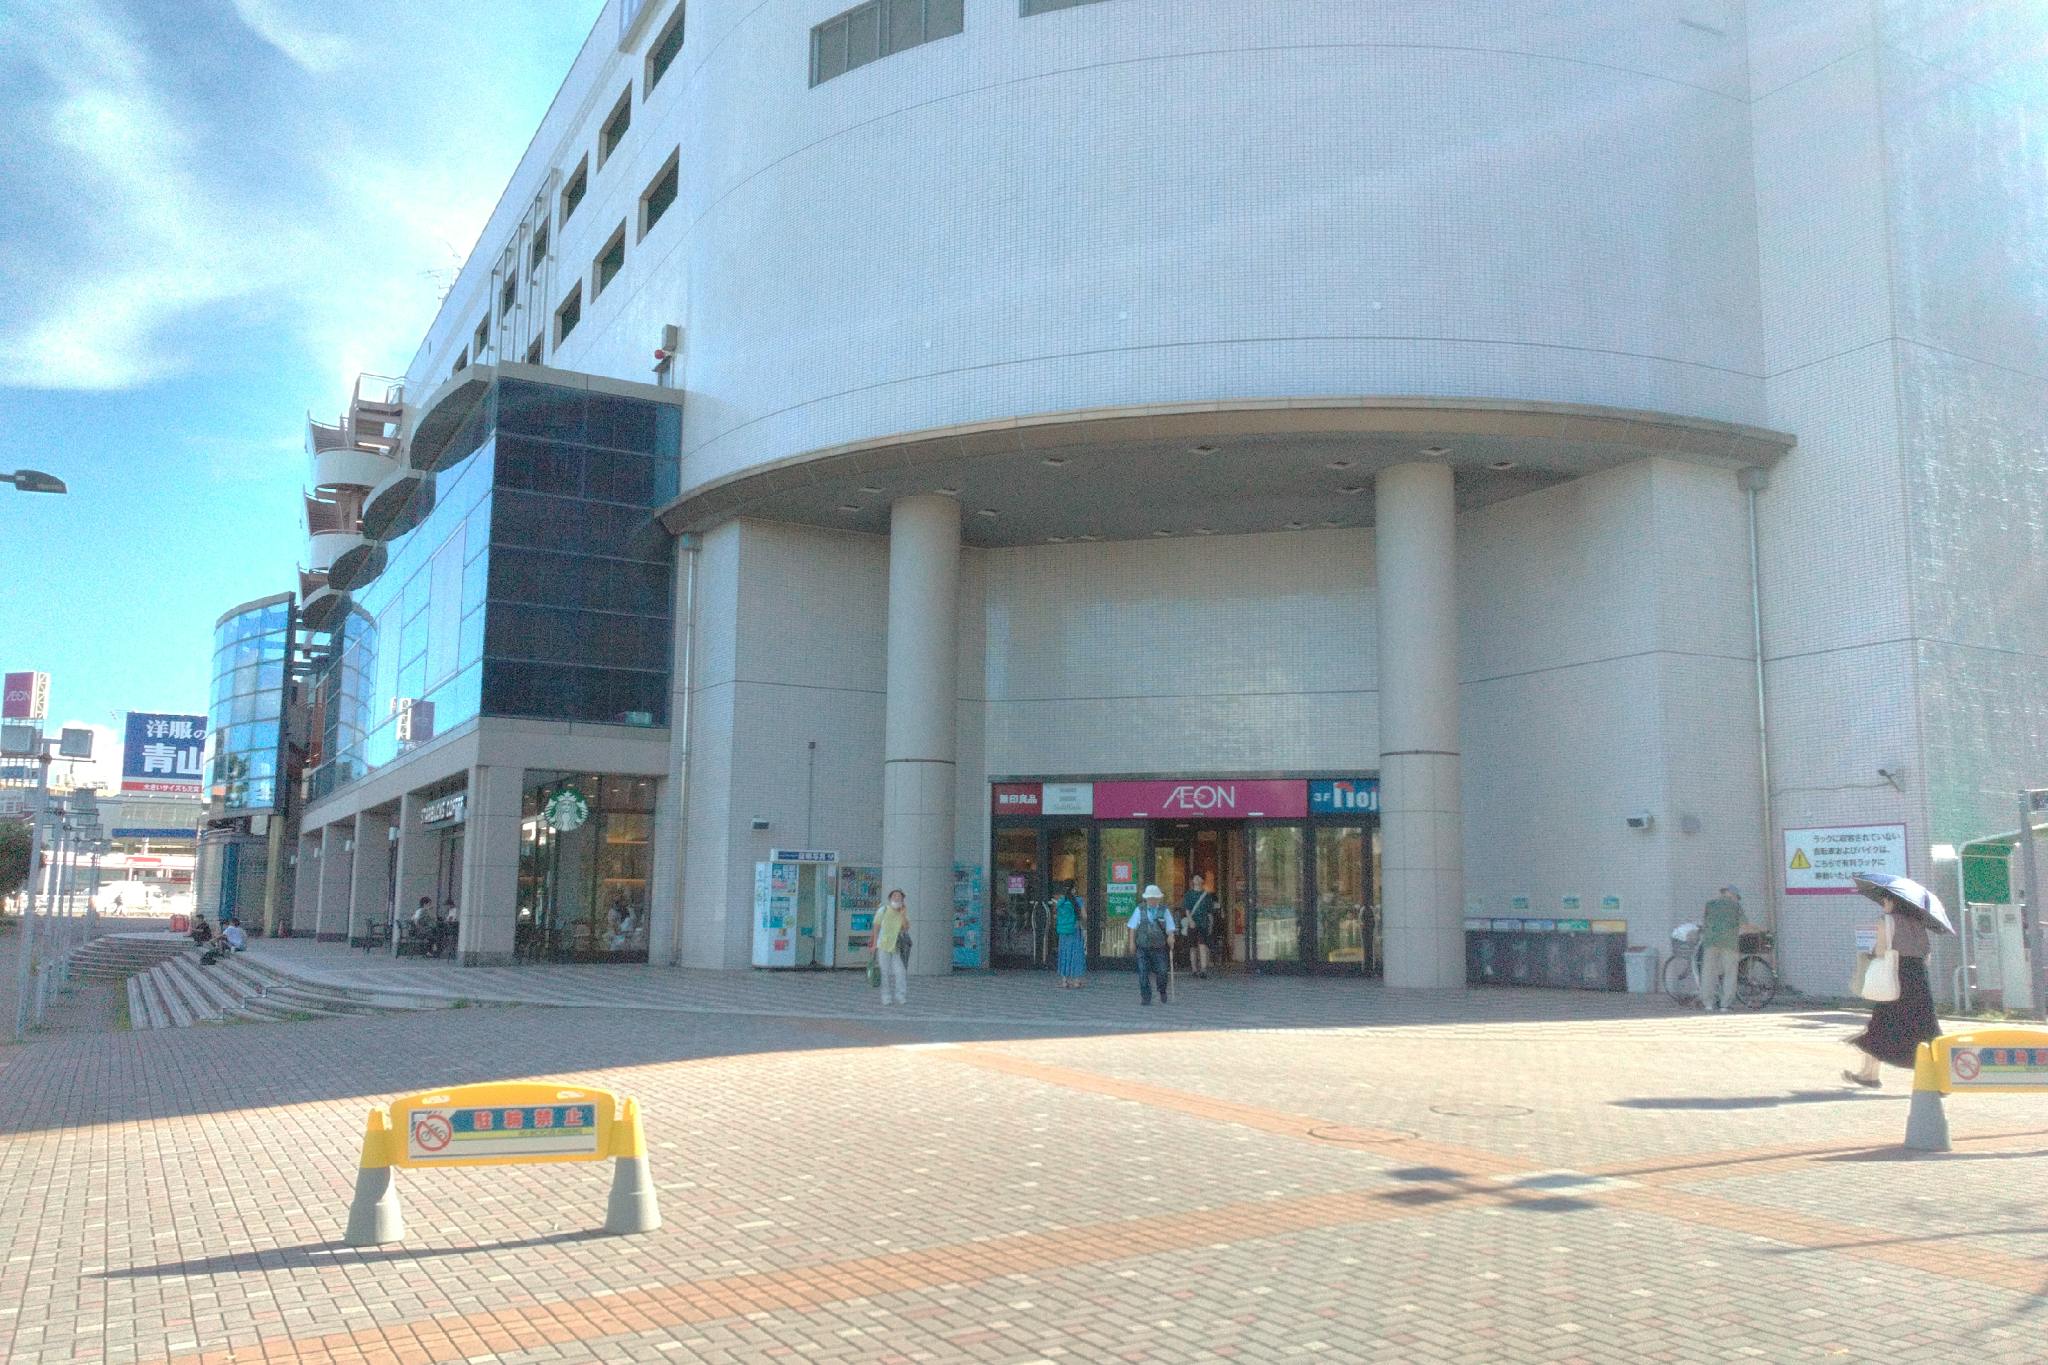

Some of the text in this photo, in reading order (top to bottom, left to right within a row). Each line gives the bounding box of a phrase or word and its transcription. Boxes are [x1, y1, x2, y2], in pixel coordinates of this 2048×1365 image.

[146, 719, 208, 740] 洋服の
[142, 742, 204, 775] 青山
[999, 794, 1037, 804] 無印良品
[1312, 792, 1332, 802] 3F
[474, 1107, 583, 1129] 駐輪禁止
